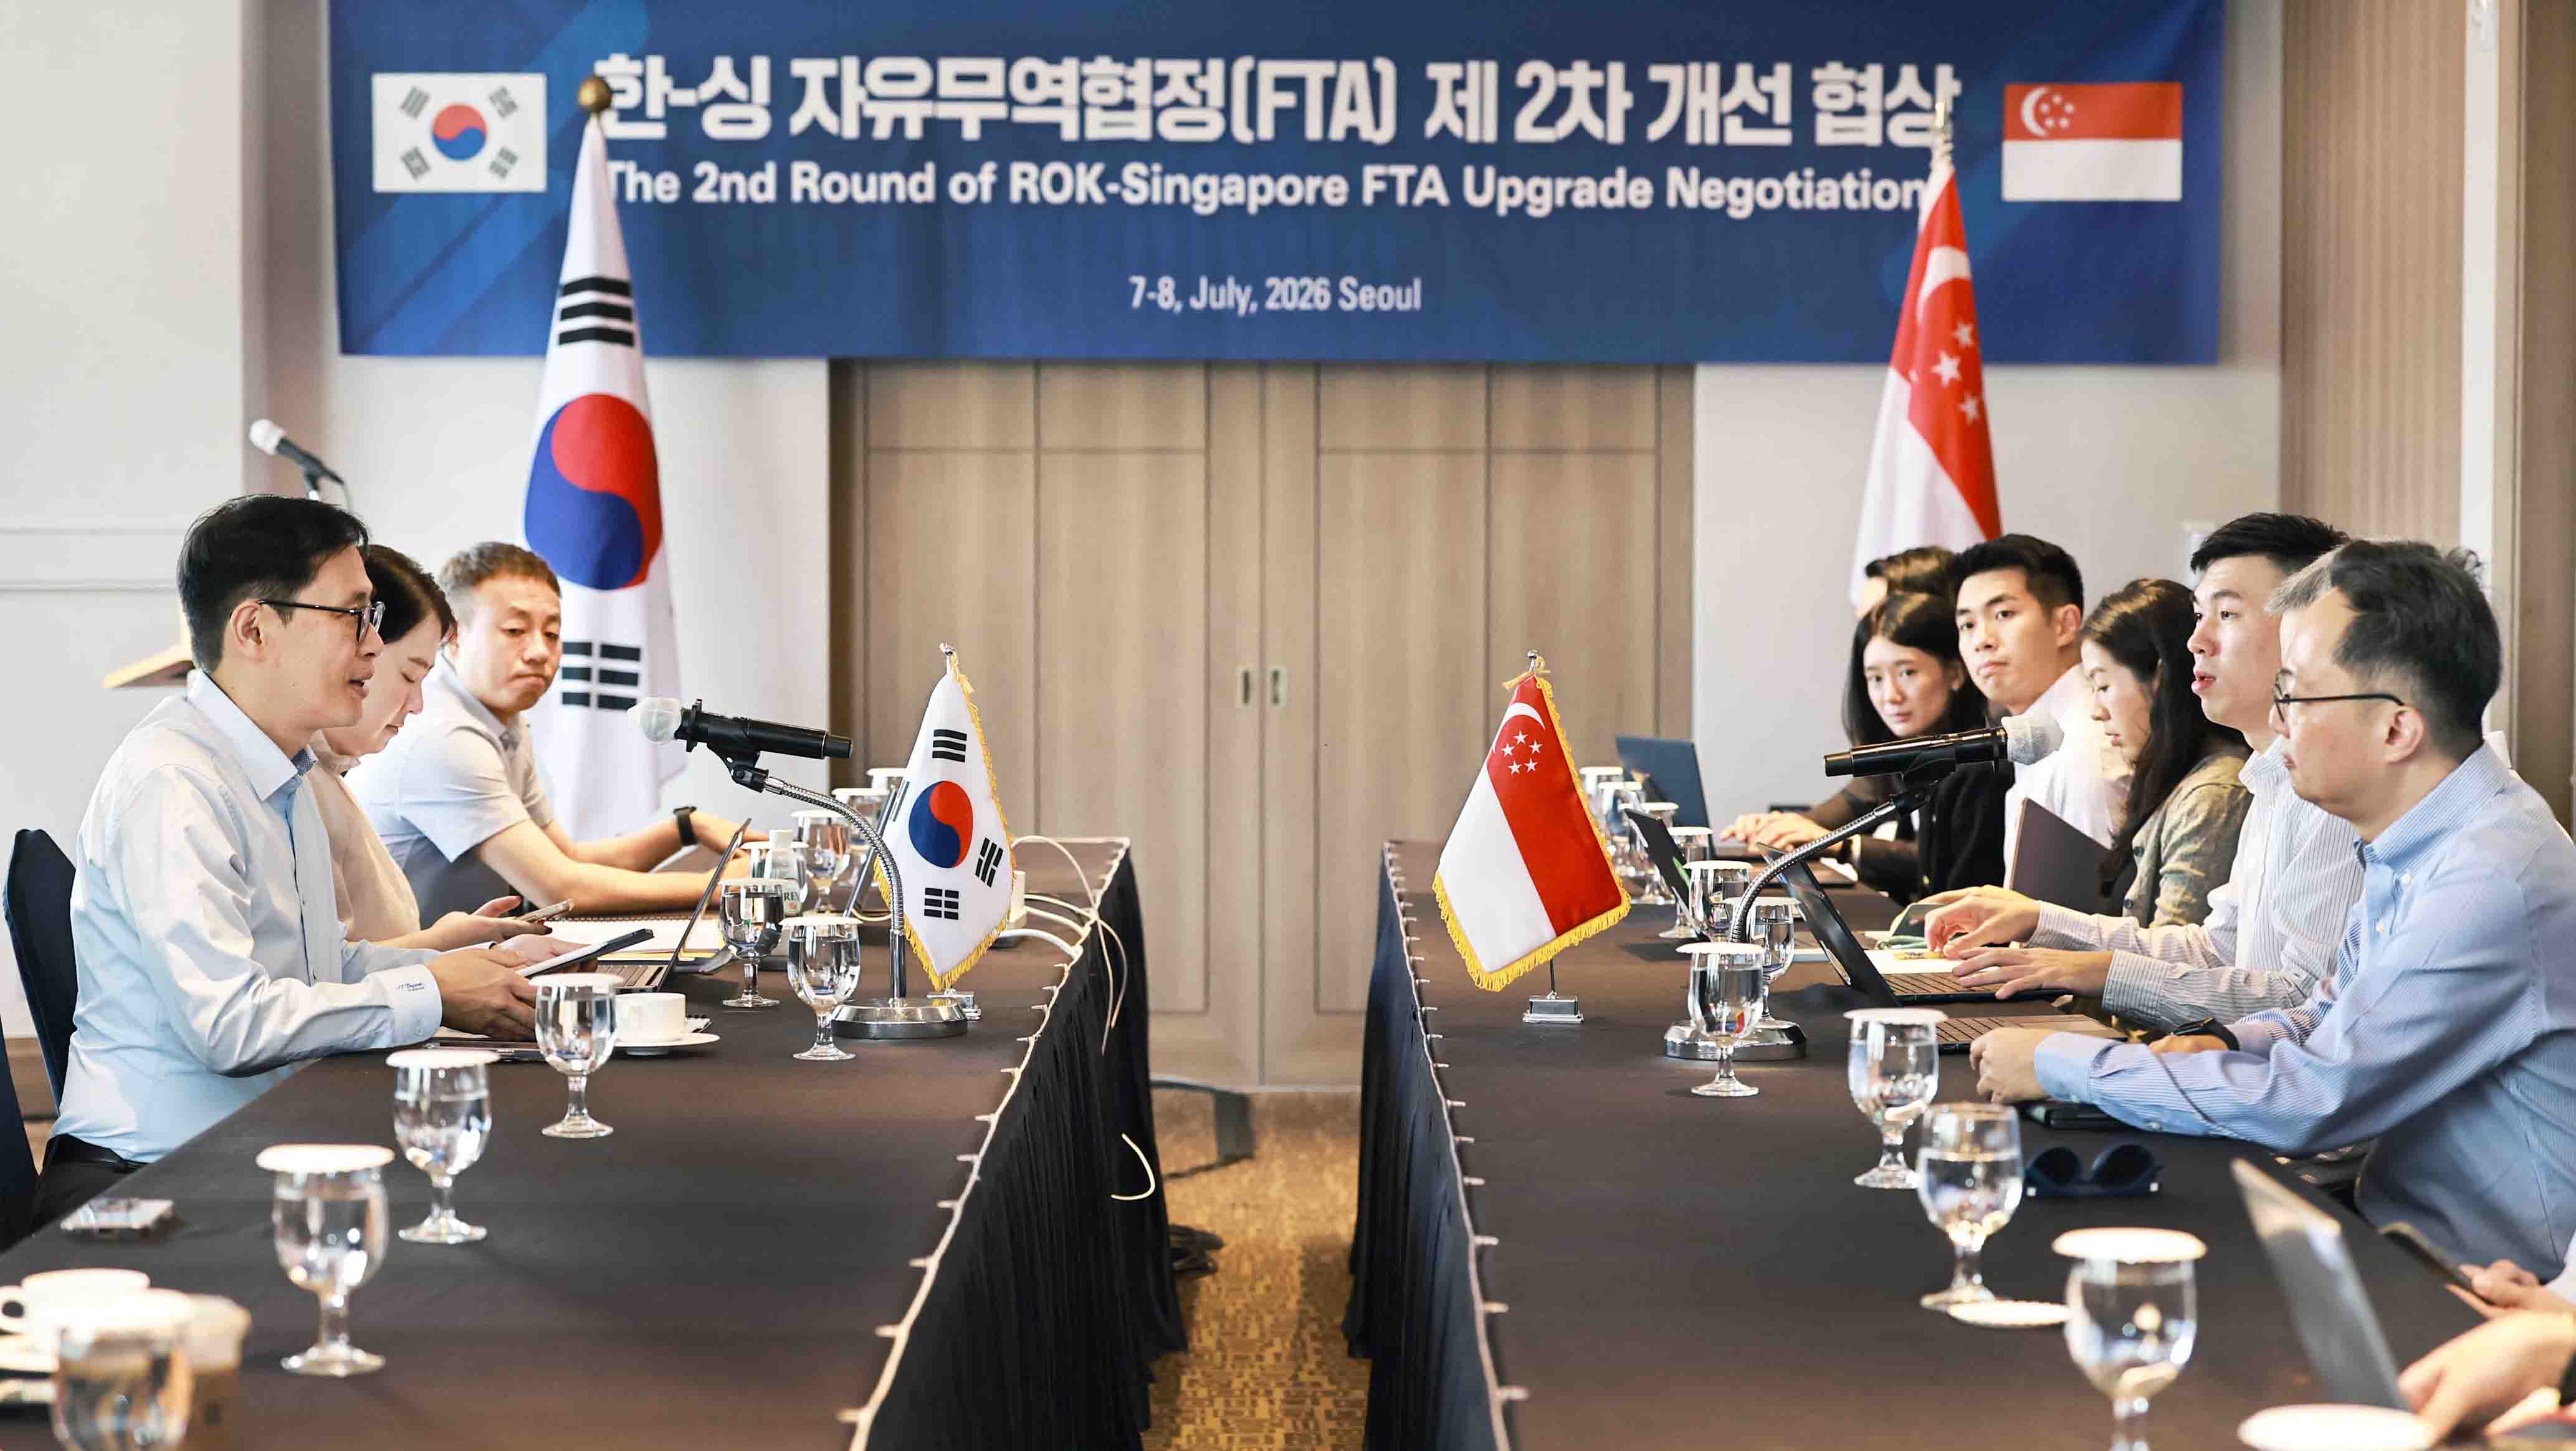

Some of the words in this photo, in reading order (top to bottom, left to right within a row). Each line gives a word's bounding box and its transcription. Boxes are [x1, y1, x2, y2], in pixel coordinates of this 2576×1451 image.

[594, 53, 771, 140] 한-싱
[789, 55, 1396, 145] 자유무역협정(FTA)
[1425, 60, 1498, 143] 제
[1515, 60, 1633, 145] 2차
[1647, 62, 1793, 146] 개선
[1811, 61, 1962, 148] 협상
[608, 160, 680, 203] The
[692, 160, 777, 203] 2nd
[791, 160, 936, 204] Round
[948, 161, 998, 204] of
[1009, 161, 1349, 215] ROK-Singapore
[1362, 164, 1450, 206] FTA
[1464, 165, 1654, 218] Upgrade
[1129, 275, 1182, 312] 7-8,
[1189, 277, 1257, 317] July,
[1266, 277, 1332, 310] 2026
[1338, 276, 1421, 311] Seoul
